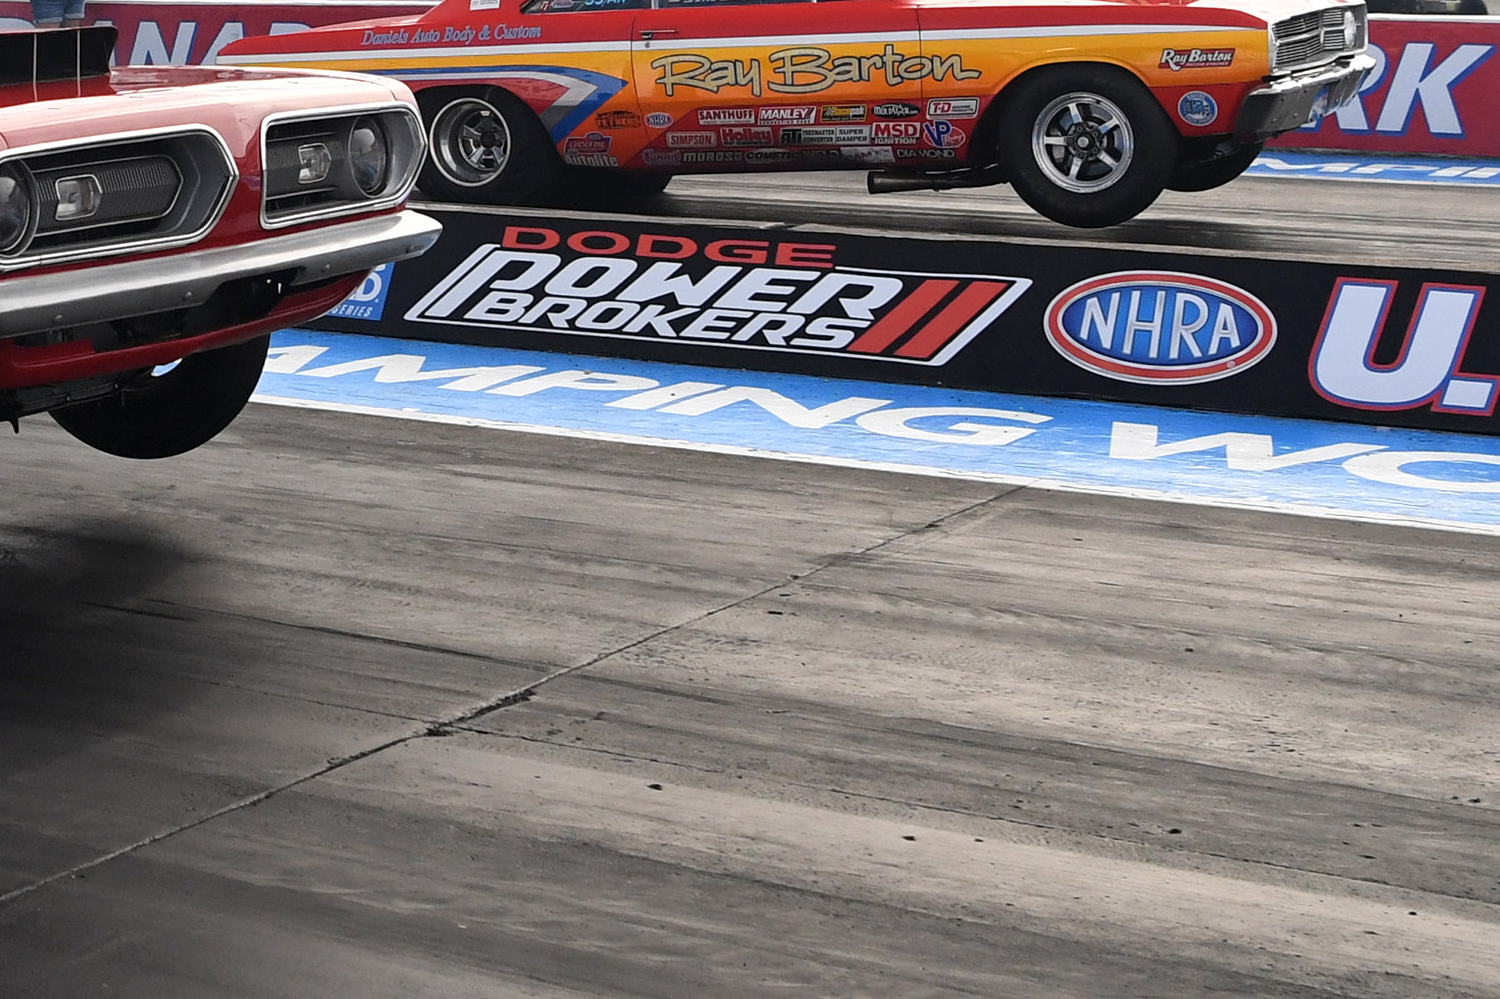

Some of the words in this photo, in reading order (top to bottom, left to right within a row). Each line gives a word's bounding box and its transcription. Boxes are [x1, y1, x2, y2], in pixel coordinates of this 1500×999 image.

[361, 29, 409, 46] Daniels
[410, 27, 441, 43] Auto
[442, 26, 476, 45] Body
[478, 25, 491, 41] &
[494, 24, 542, 39] Custom
[1161, 49, 1187, 71] Ray
[1188, 48, 1233, 63] Barton
[651, 53, 761, 96] Ray
[768, 43, 983, 95] Barton
[648, 114, 669, 126] NHRA
[699, 109, 753, 120] SANTHUFF
[760, 108, 808, 120] MANLEY
[838, 128, 864, 136] SUPER
[874, 123, 918, 137] MSD
[923, 119, 953, 148] VP
[670, 134, 712, 145] SIMPSON
[836, 135, 868, 143] DAMPER
[875, 137, 917, 145] IGNITION
[565, 154, 619, 167] Autolite
[684, 151, 743, 162] MOROSO
[897, 149, 956, 160] DIAMOND
[502, 226, 836, 268] DODGE
[430, 251, 904, 320] POWER
[331, 304, 373, 318] SERIES
[482, 295, 857, 350] BROKERS
[1080, 289, 1242, 361] NHRA
